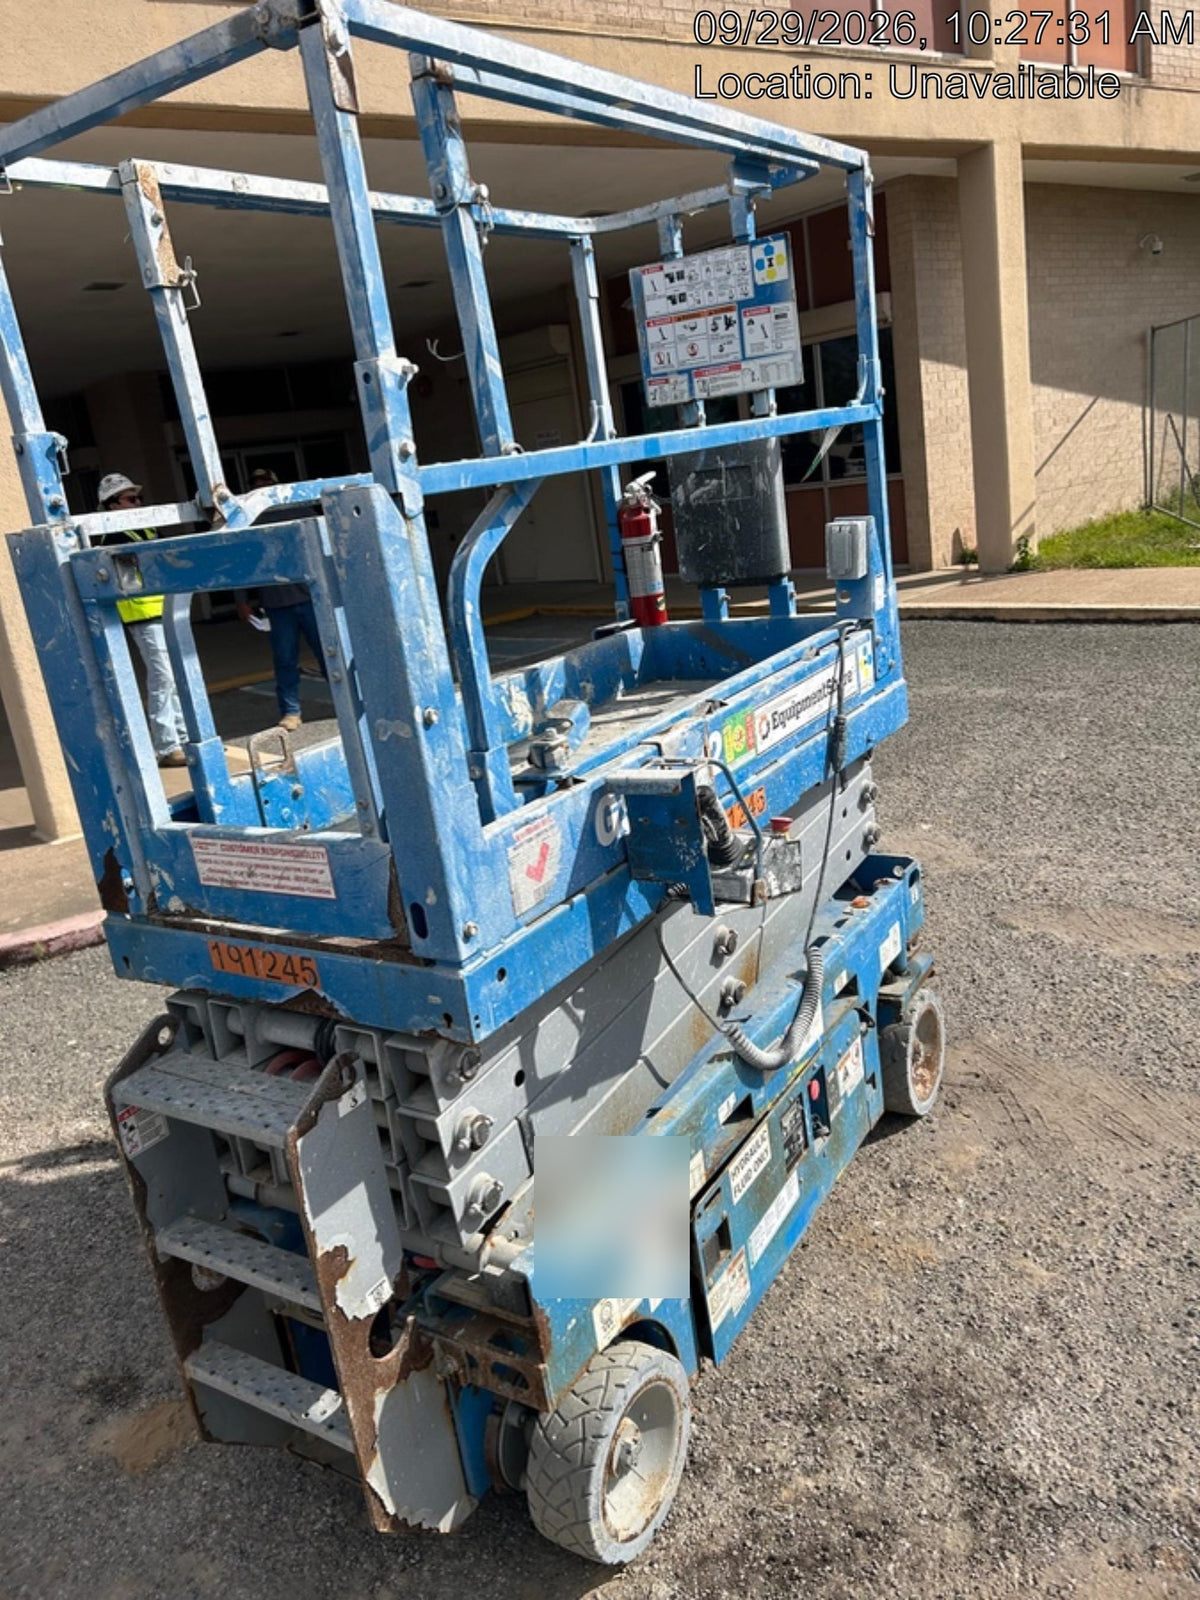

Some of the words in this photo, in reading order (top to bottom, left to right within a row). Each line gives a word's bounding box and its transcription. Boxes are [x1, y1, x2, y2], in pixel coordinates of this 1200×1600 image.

[771, 670, 852, 730] EquipmentShre
[211, 941, 318, 988] 191245
[731, 1129, 768, 1182] HYDRAULIC
[733, 1168, 753, 1199] FLUID
